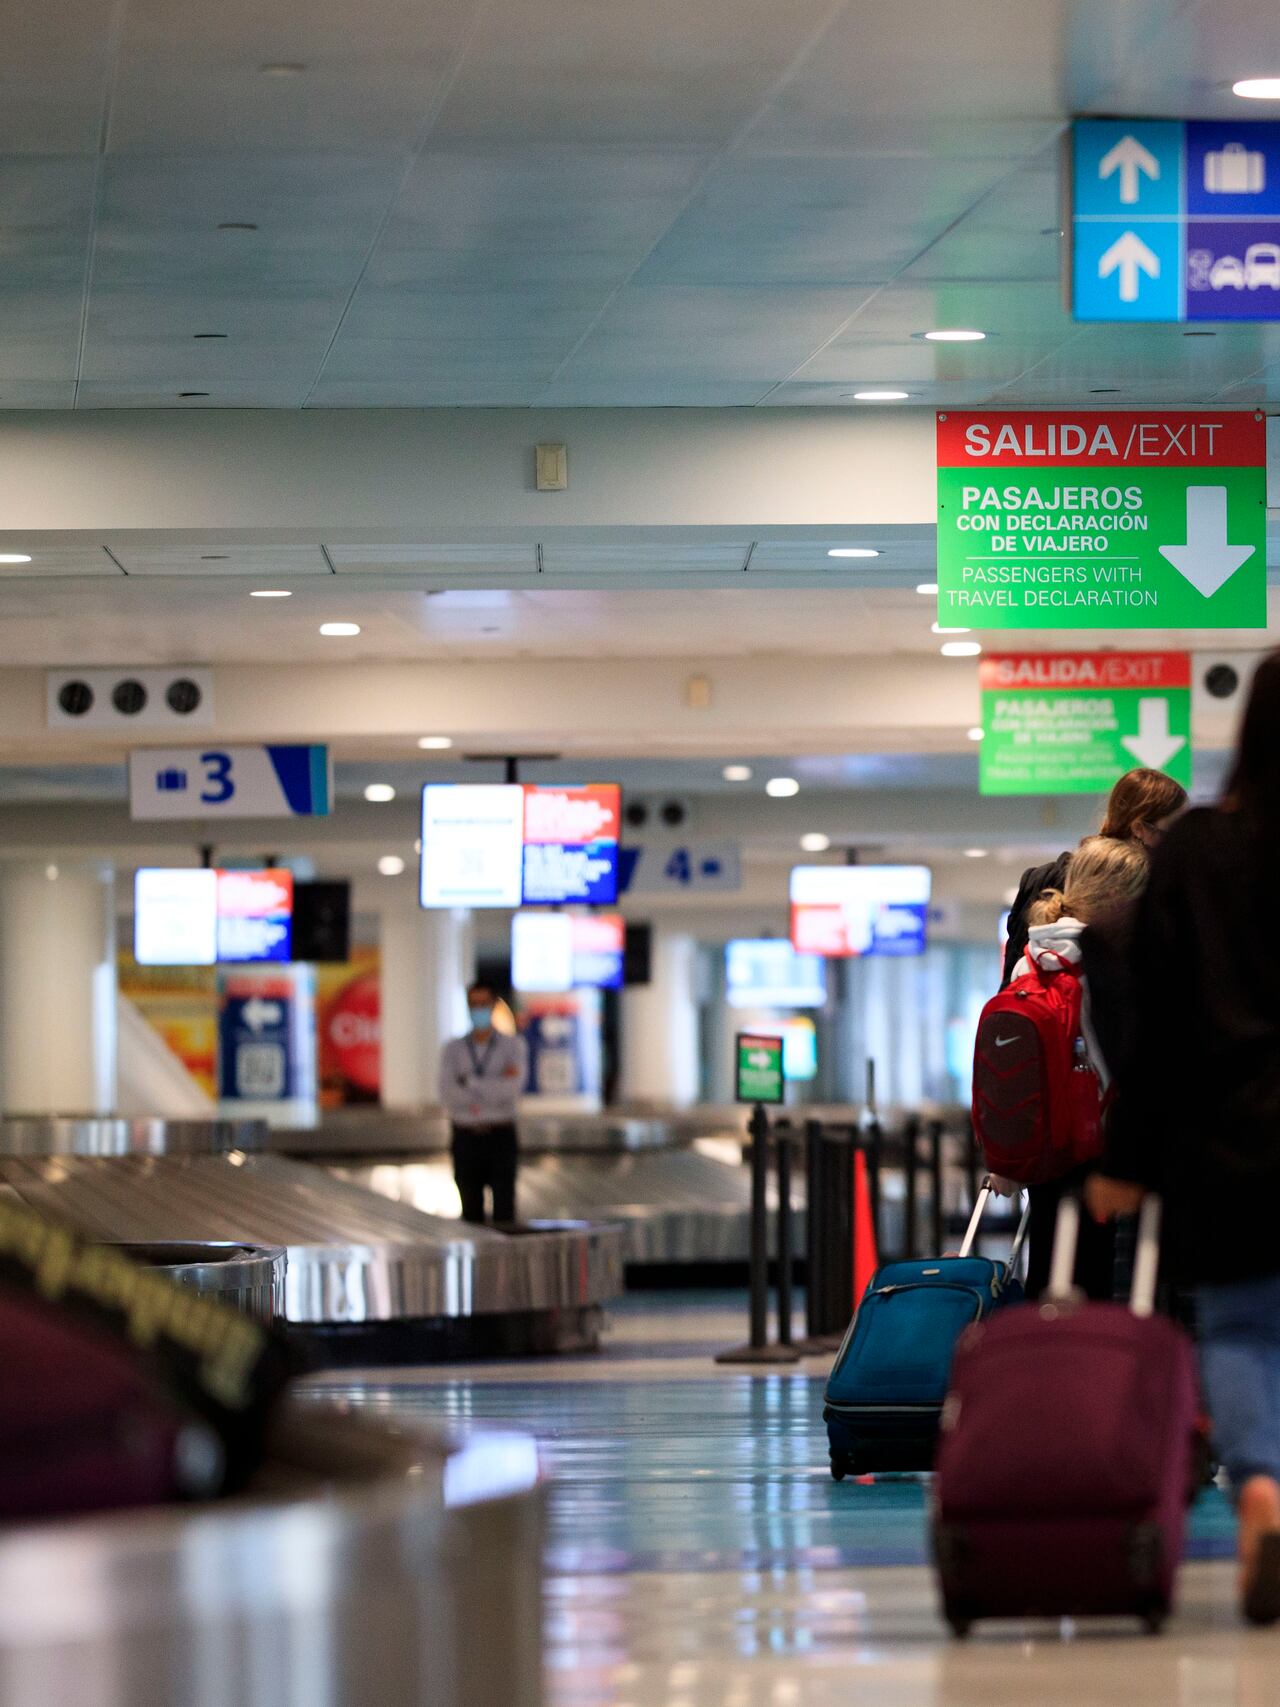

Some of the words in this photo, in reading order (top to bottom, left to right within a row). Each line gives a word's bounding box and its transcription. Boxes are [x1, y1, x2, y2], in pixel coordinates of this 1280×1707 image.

[962, 486, 1143, 511] PASAJEROS
[956, 515, 999, 531] CON
[1006, 511, 1149, 531] DECLARACIÓN
[991, 536, 1017, 552] DE
[1022, 535, 1109, 552] VIAJERO
[962, 566, 1087, 583] PASSENGERS
[1092, 567, 1142, 583] WITH
[946, 590, 1018, 606] TRAVEL
[1024, 590, 1158, 606] DECLARATION
[200, 752, 235, 804] 3
[664, 848, 691, 883] 4
